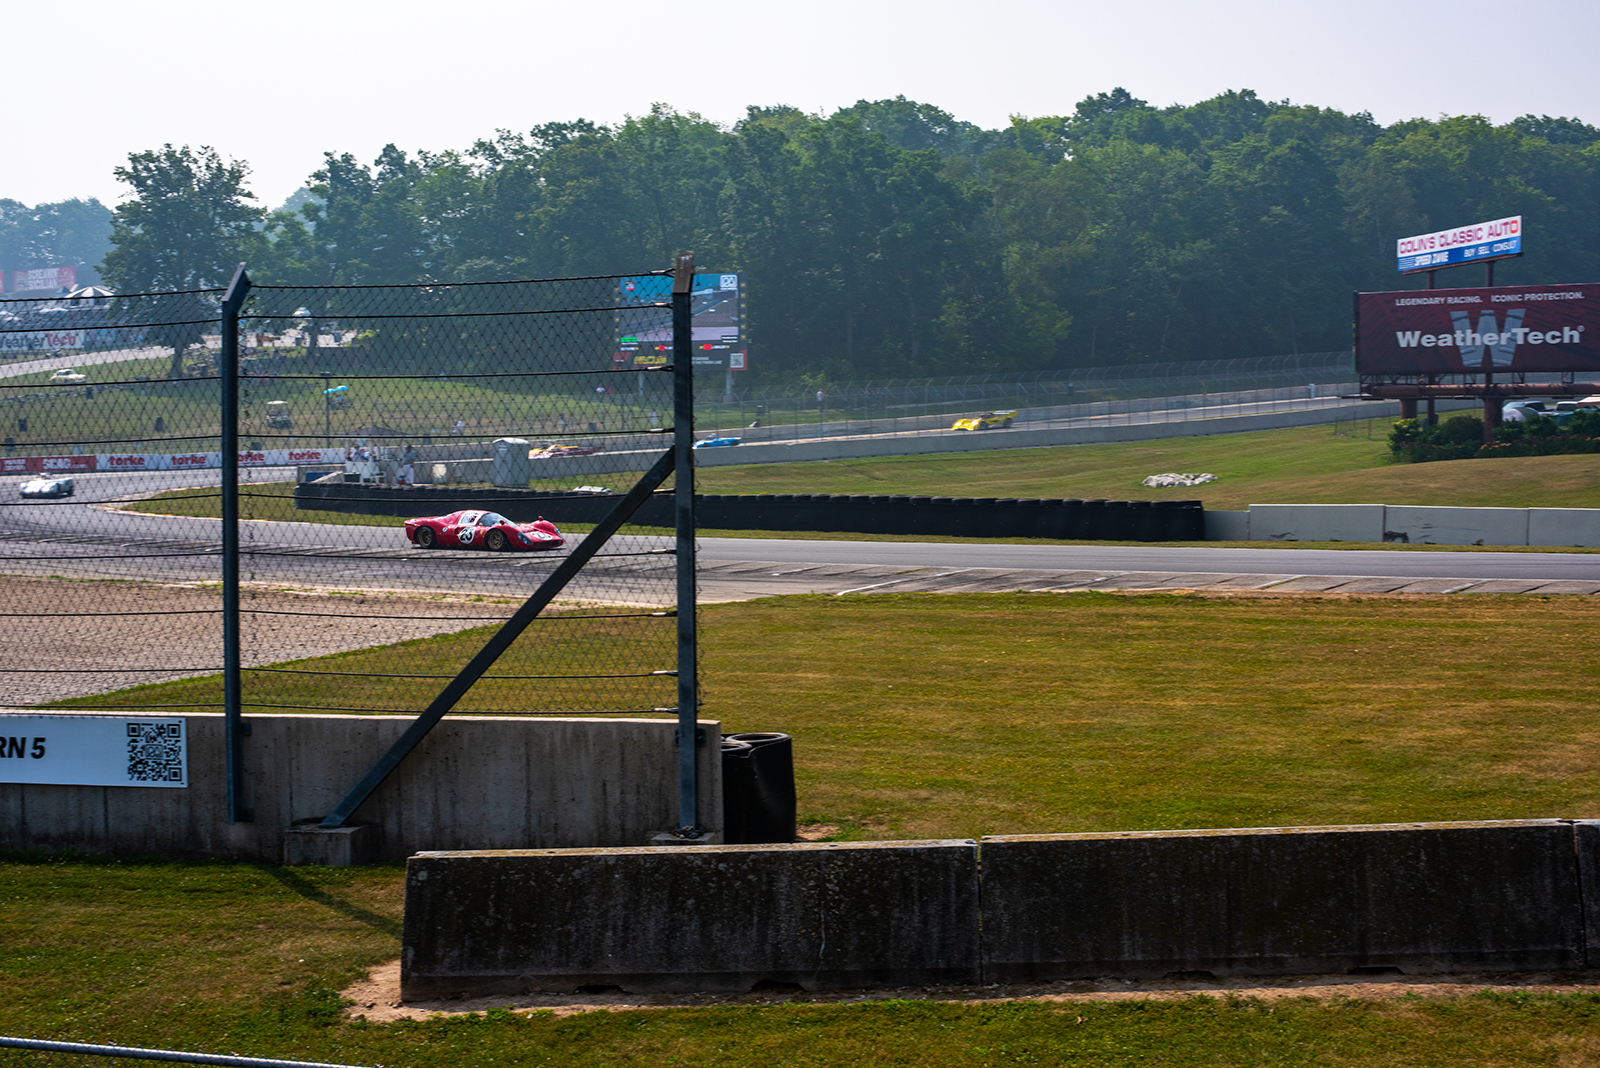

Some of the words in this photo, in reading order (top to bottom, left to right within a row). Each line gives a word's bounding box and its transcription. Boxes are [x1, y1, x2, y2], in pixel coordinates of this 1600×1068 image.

[1399, 236, 1435, 254] COLIN'S
[1439, 227, 1484, 247] CLASSIC
[1487, 219, 1519, 238] AUTO
[1395, 296, 1446, 307] LEGENDARY
[1447, 295, 1483, 305] RACING.
[1491, 294, 1523, 303] ICONIC
[1524, 291, 1585, 302] PROTECTION.
[109, 455, 145, 465] torke
[171, 454, 206, 464] torke
[237, 451, 265, 462] orke
[288, 450, 321, 461] torke
[30, 737, 46, 759] 5
